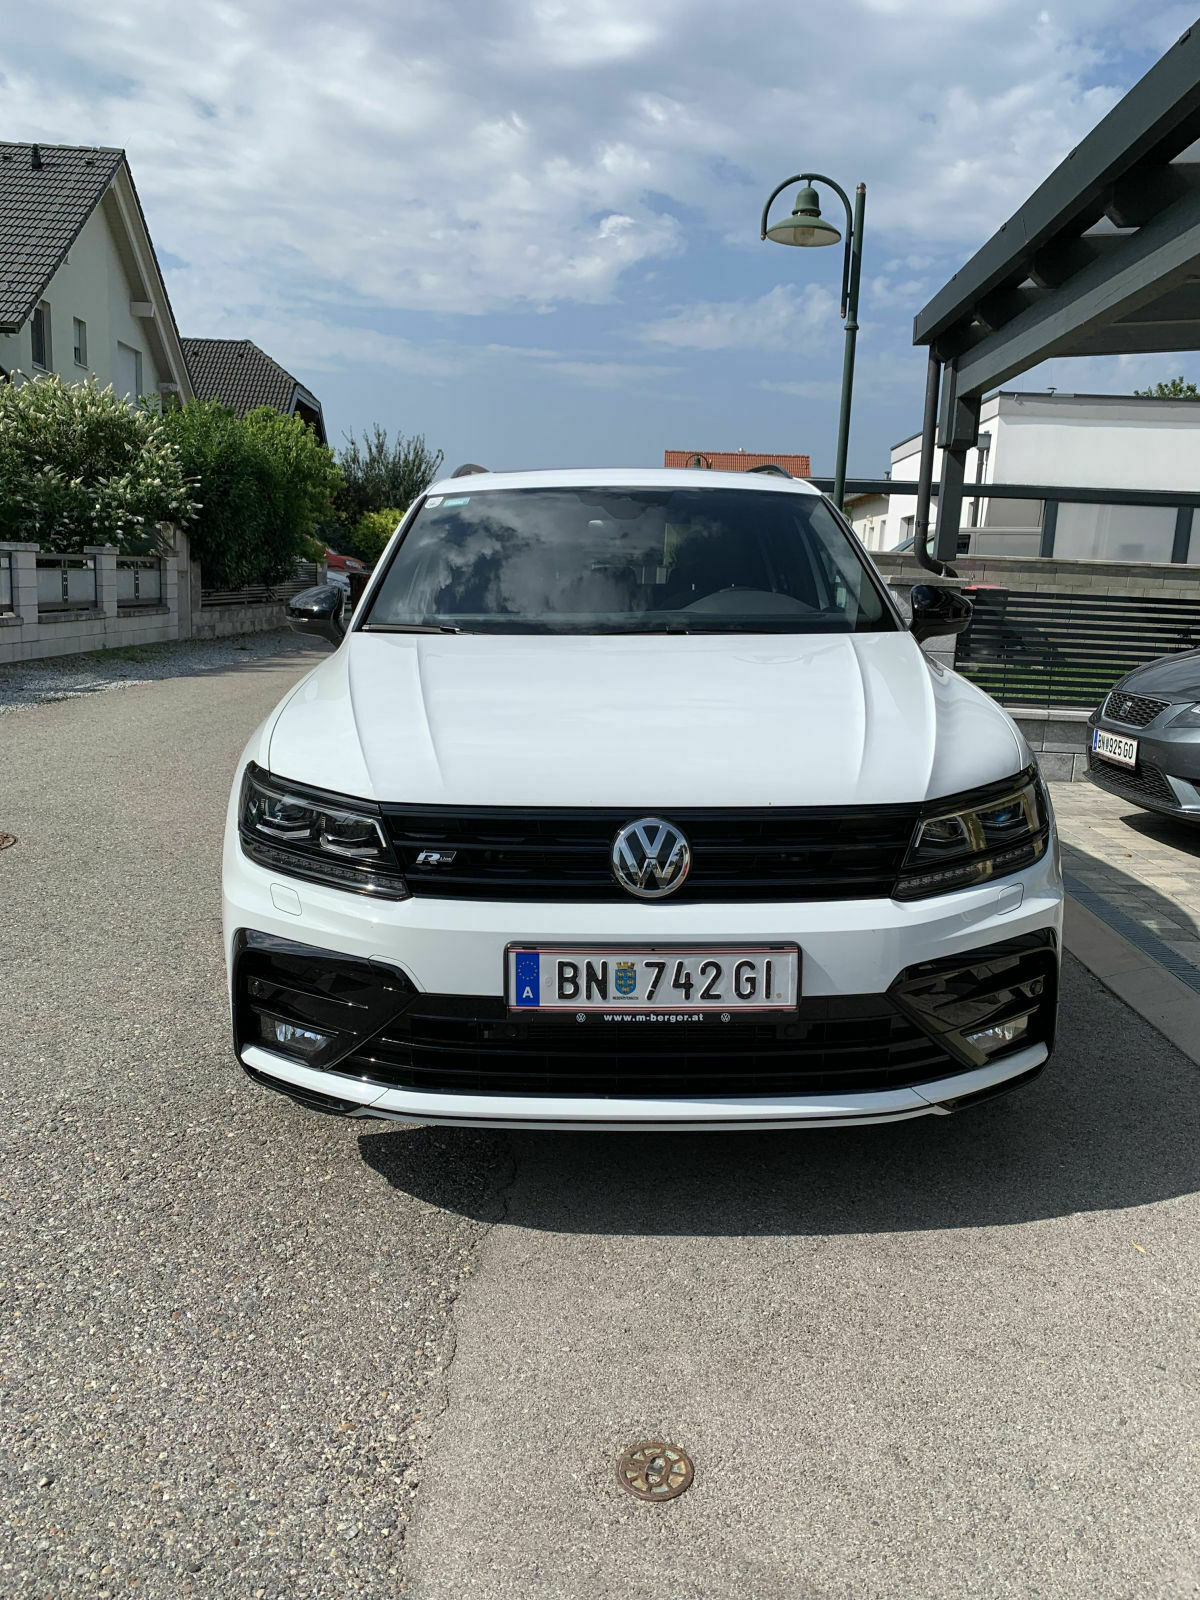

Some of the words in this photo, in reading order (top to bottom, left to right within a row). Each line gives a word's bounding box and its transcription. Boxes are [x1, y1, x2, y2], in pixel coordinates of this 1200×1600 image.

[557, 960, 608, 1000] BN
[522, 986, 533, 998] A
[603, 1013, 704, 1023] www.m-berger.at
